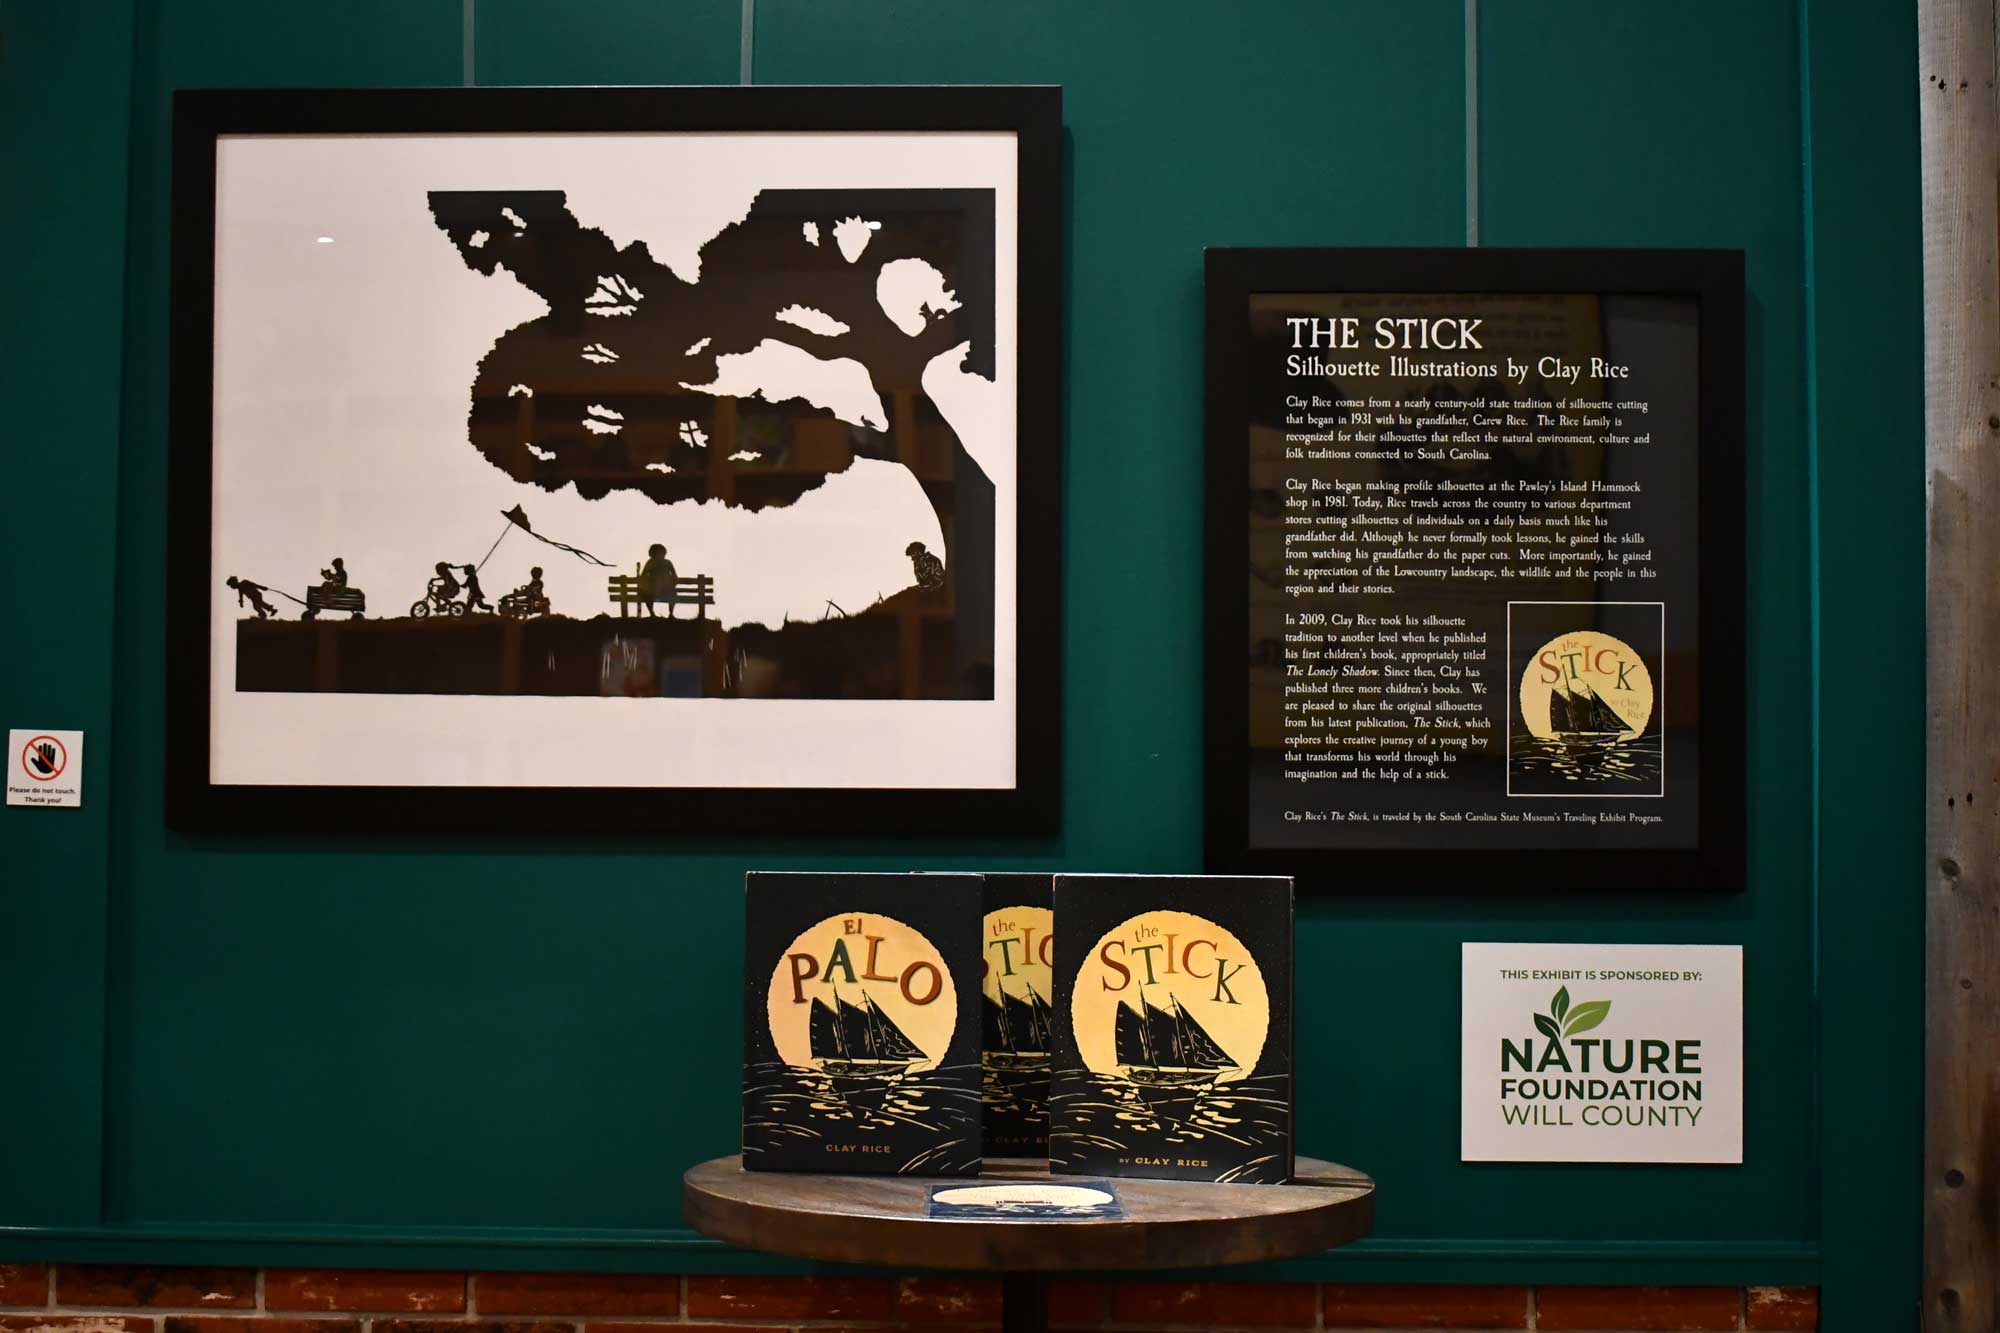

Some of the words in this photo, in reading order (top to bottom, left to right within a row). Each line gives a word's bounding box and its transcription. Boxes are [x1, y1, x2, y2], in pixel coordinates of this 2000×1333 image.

[1287, 318, 1359, 348] THE
[1375, 318, 1482, 349] STICK
[1287, 355, 1380, 376] Silhouette
[1390, 356, 1497, 376] Illustrations
[1507, 358, 1528, 384] by
[1538, 357, 1580, 384] Clay
[1590, 358, 1628, 378] Rice
[1286, 396, 1308, 410] Clay
[1312, 396, 1331, 407] Rice
[1369, 396, 1391, 407] from
[1404, 397, 1430, 410] nearly
[1435, 398, 1484, 411] century-old
[1514, 398, 1552, 408] tradition
[1556, 398, 1566, 408] of
[1570, 398, 1612, 408] silhouette
[1617, 401, 1648, 413] cutting
[1286, 447, 1304, 458] folk
[1308, 448, 1351, 458] traditions
[1355, 449, 1400, 459] connected
[1418, 448, 1445, 459] South
[1450, 448, 1491, 459] Carolina.
[1286, 478, 1308, 493] Clay
[1312, 478, 1331, 490] Rice
[1335, 479, 1362, 494] began
[1366, 480, 1400, 494] making
[1404, 480, 1433, 494] profile
[1437, 480, 1484, 490] silhouettes
[1501, 481, 1515, 491] the
[1520, 480, 1556, 494] Pawley's
[1560, 480, 1587, 491] Island
[1592, 481, 1640, 492] Hammock
[1286, 614, 1295, 624] In
[1299, 614, 1327, 625] 2009,
[1331, 614, 1353, 628] Clay
[1357, 614, 1376, 625] Rice
[1381, 615, 1401, 625] took
[1406, 615, 1419, 625] his
[1423, 615, 1465, 625] silhouette
[1285, 631, 1323, 642] tradition
[1341, 632, 1374, 642] another
[1378, 632, 1398, 642] level
[1402, 632, 1425, 642] when
[1429, 632, 1439, 642] he
[1444, 632, 1486, 646] published
[1562, 640, 1578, 652] the
[1285, 648, 1298, 658] his
[1302, 648, 1320, 659] first
[1324, 648, 1367, 659] children's
[1371, 649, 1397, 660] book,
[1401, 650, 1459, 663] appropriately
[1463, 649, 1486, 660] titled
[1287, 665, 1304, 676] The
[1307, 665, 1338, 679] Lonely
[1342, 665, 1380, 676] Shadow.
[1384, 665, 1410, 676] Since
[1414, 666, 1436, 677] then,
[1440, 665, 1461, 680] Clay
[1466, 666, 1480, 676] has
[1539, 646, 1638, 690] STICK
[1285, 682, 1328, 696] published
[1332, 682, 1354, 693] three
[1386, 683, 1428, 693] children's
[1432, 683, 1462, 693] books.
[1472, 683, 1487, 694] We
[1302, 700, 1334, 714] pleased
[1352, 700, 1375, 710] share
[1380, 700, 1393, 710] the
[1397, 700, 1431, 714] original
[1436, 700, 1482, 711] silhouettes
[1285, 716, 1307, 727] from
[1311, 716, 1324, 727] his
[1328, 717, 1351, 727] latest
[1356, 717, 1408, 731] publication,
[1414, 717, 1431, 728] The
[1434, 717, 1461, 728] Stick,
[1465, 717, 1491, 728] which
[1285, 734, 1321, 748] explores
[1325, 734, 1339, 744] the
[1343, 736, 1376, 744] creative
[1380, 736, 1414, 748] journey
[1417, 734, 1427, 744] of
[1440, 738, 1467, 749] young
[1472, 734, 1488, 748] boy
[1285, 751, 1302, 761] that
[1306, 751, 1354, 761] transforms
[1358, 751, 1371, 761] his
[1375, 751, 1400, 761] world
[1404, 751, 1439, 766] through
[1444, 751, 1456, 762] his
[1285, 770, 1338, 782] imagination
[1342, 768, 1358, 778] and
[1362, 768, 1376, 778] the
[1380, 768, 1399, 782] help
[1403, 768, 1413, 778] of
[1426, 769, 1448, 779] stick.
[992, 919, 1016, 936] the
[1134, 924, 1159, 942] the
[788, 935, 942, 1006] PALO
[1100, 934, 1246, 1004] STICK
[1501, 970, 1528, 979] THIS
[1533, 970, 1581, 979] EXHIBIT
[1586, 971, 1596, 980] IS
[1600, 971, 1679, 980] SPONSORED
[1683, 972, 1702, 980] BY:
[1502, 1039, 1701, 1073] NATURE
[1501, 1079, 1701, 1100] FOUNDATION
[1502, 1105, 1573, 1125] WILL
[1582, 1106, 1702, 1126] COUNTY
[826, 1144, 856, 1152] CLAY
[862, 1145, 891, 1153] RICE
[1135, 1157, 1170, 1165] CLAY
[1177, 1159, 1208, 1167] RICE
